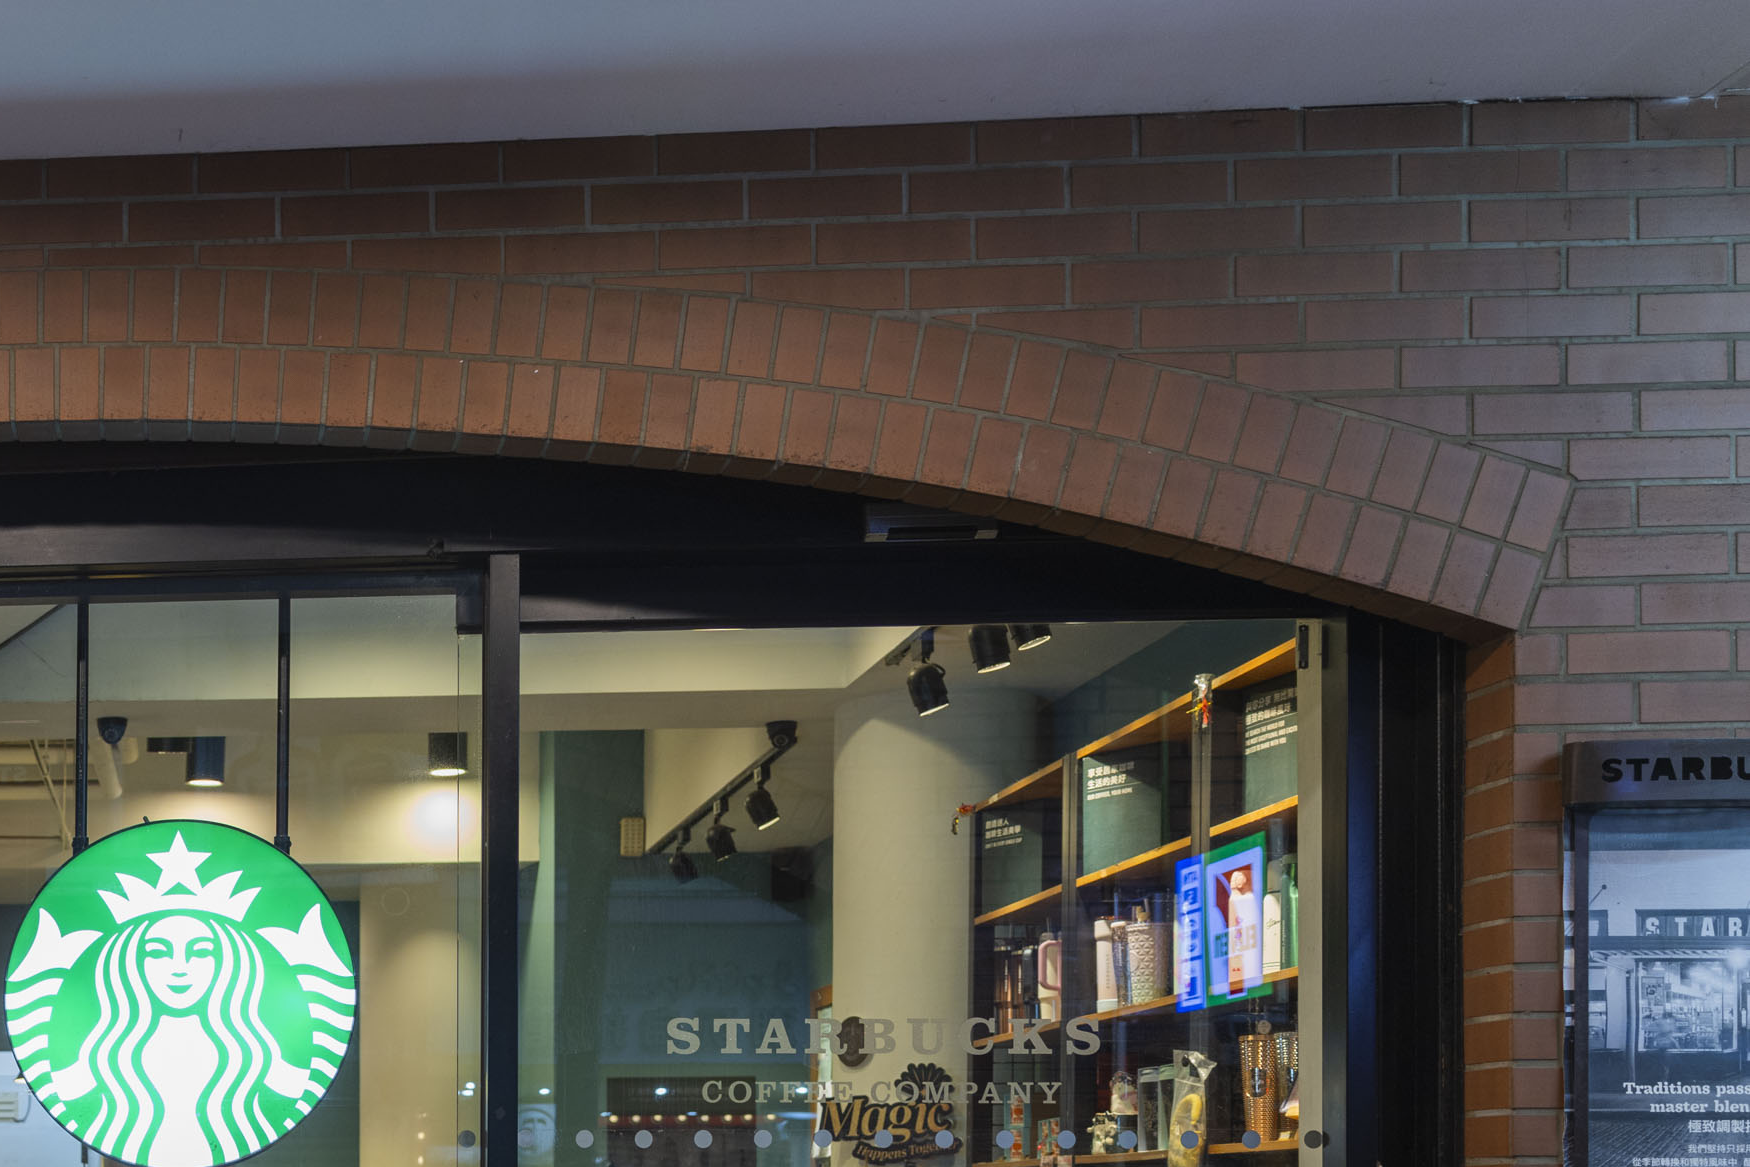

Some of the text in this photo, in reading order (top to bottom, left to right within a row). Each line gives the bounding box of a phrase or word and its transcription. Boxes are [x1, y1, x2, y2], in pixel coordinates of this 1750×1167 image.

[666, 1016, 1101, 1056] STARBUCKS
[701, 1080, 1063, 1104] COFFEE COMPANY
[1623, 1082, 1710, 1095] Traditions
[1650, 1101, 1708, 1113] master
[822, 1099, 952, 1144] Magic
